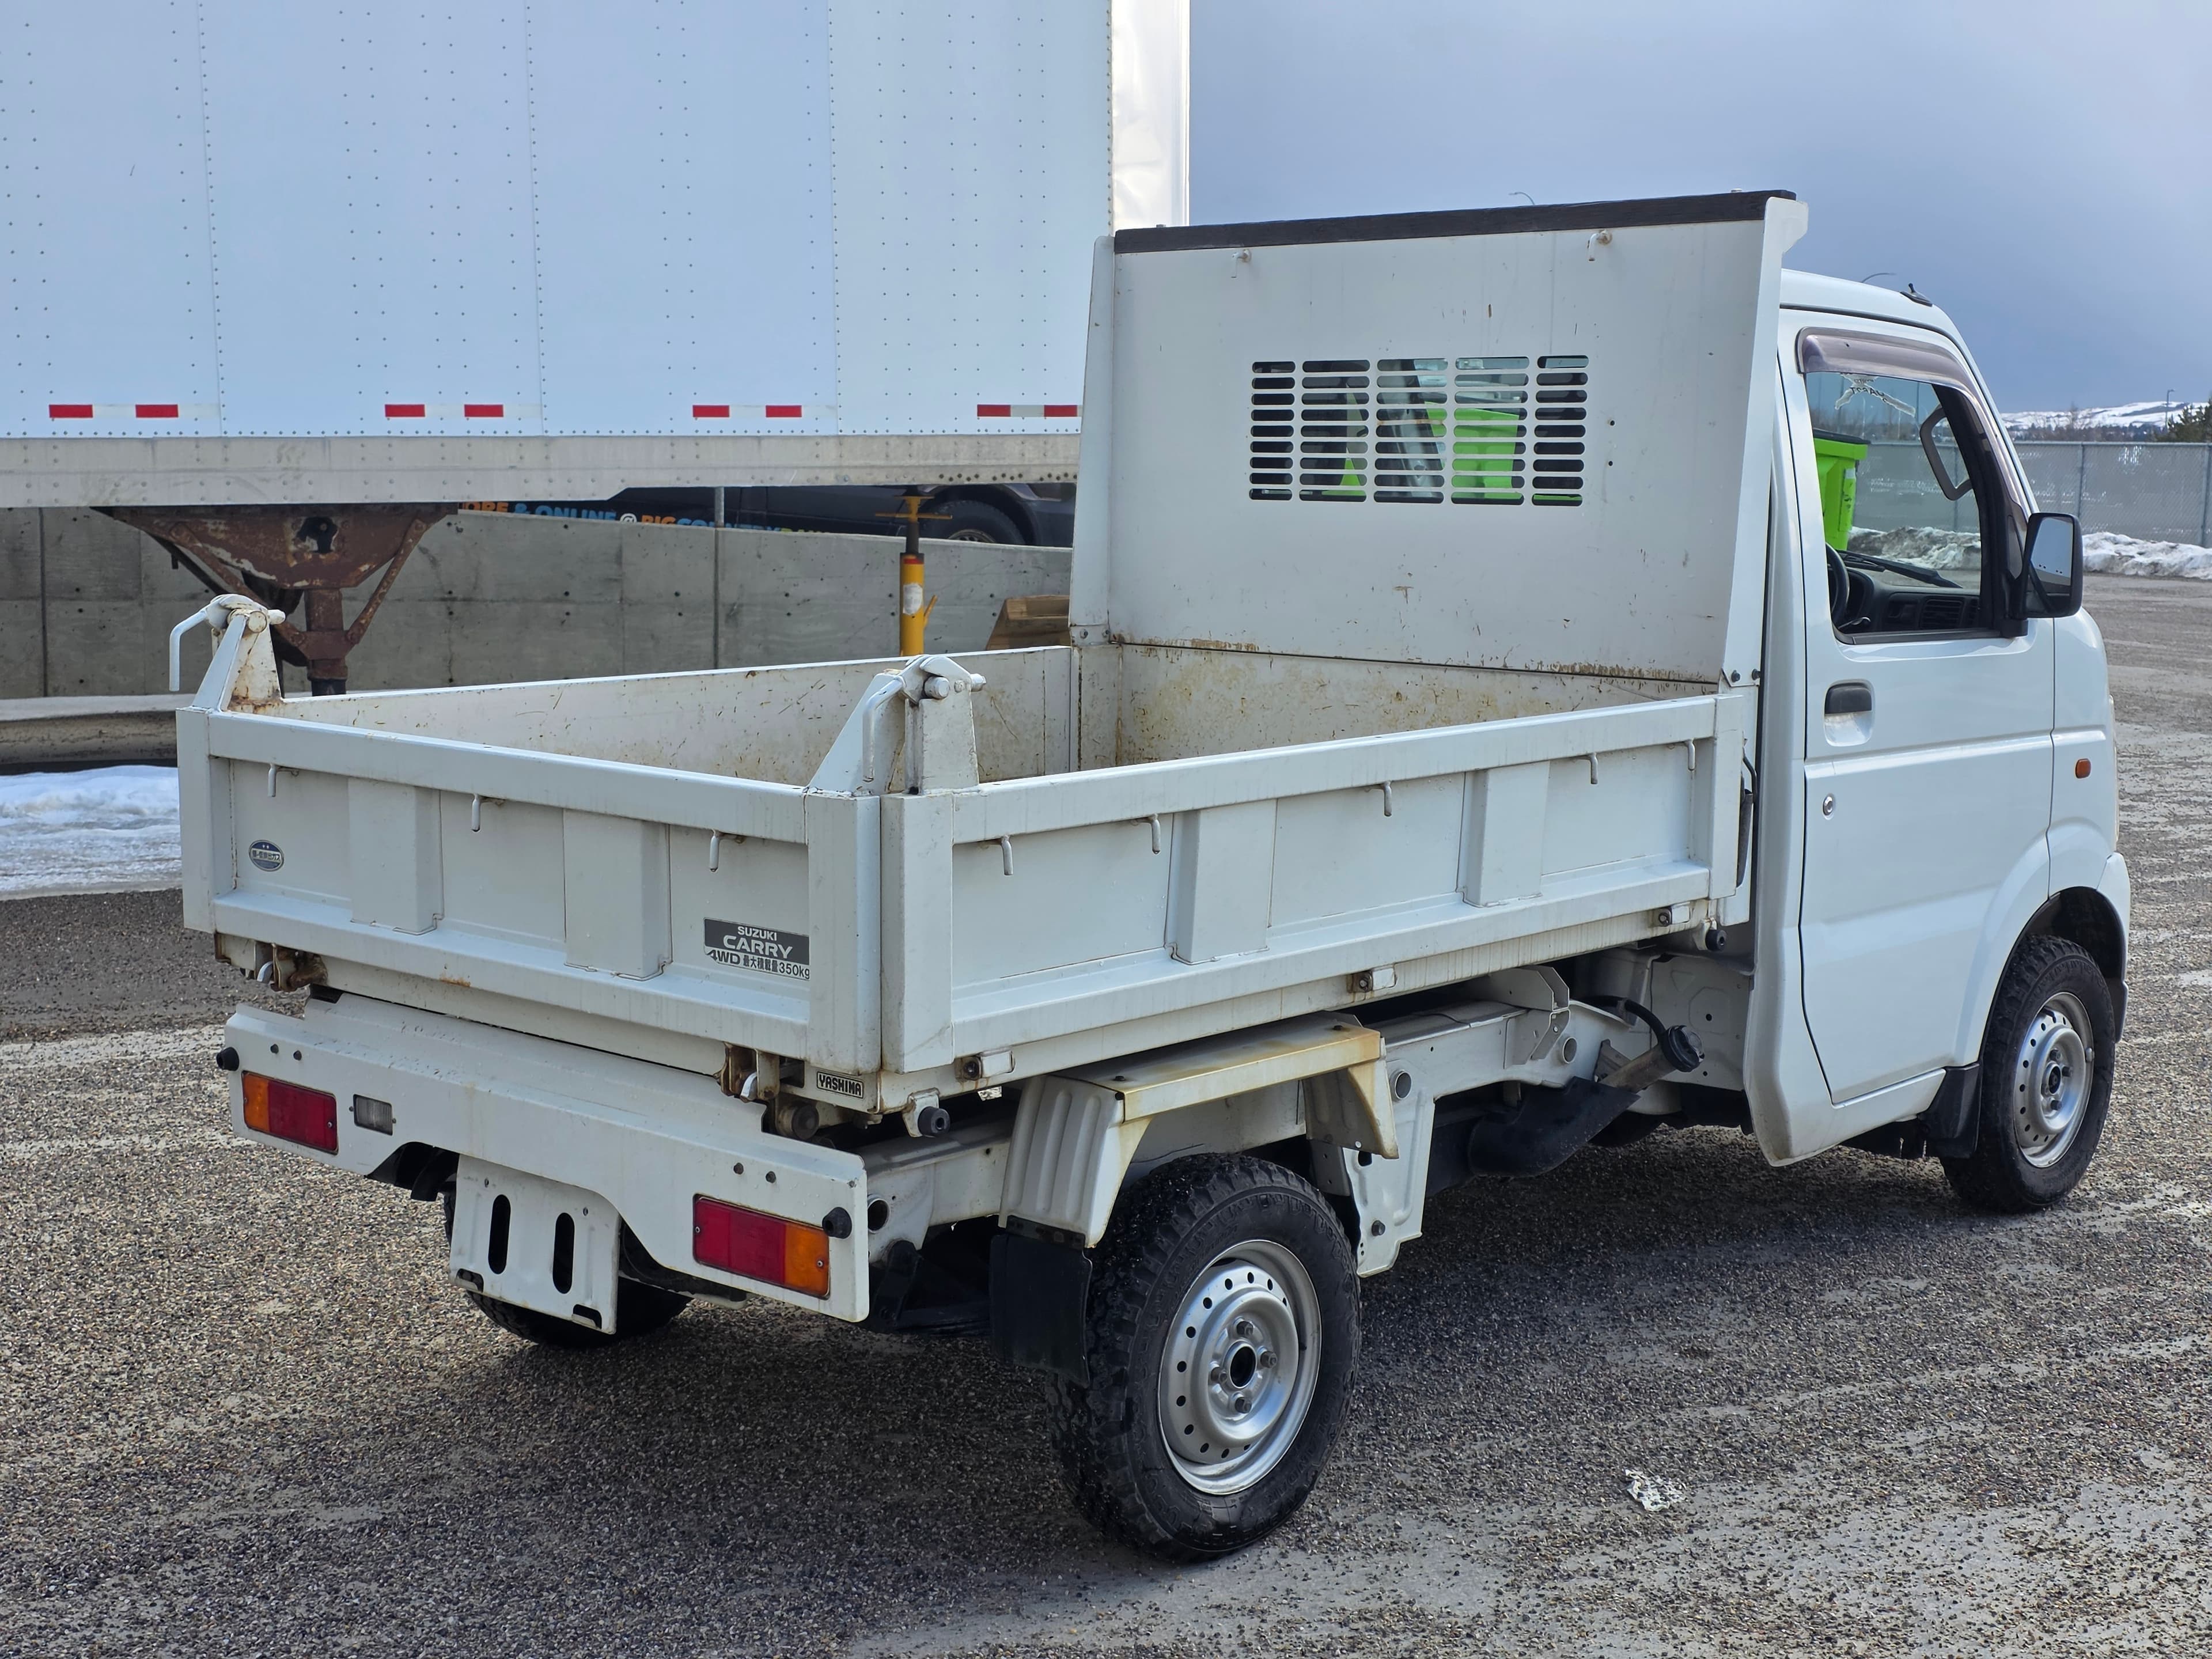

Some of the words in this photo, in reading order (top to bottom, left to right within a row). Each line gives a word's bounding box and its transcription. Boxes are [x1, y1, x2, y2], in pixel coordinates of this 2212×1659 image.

[463, 501, 509, 512] ORE
[737, 926, 777, 941] SUZUKI
[723, 934, 793, 959] CARRY
[706, 949, 741, 965] 4WD
[819, 1074, 862, 1096] YASHIMA
